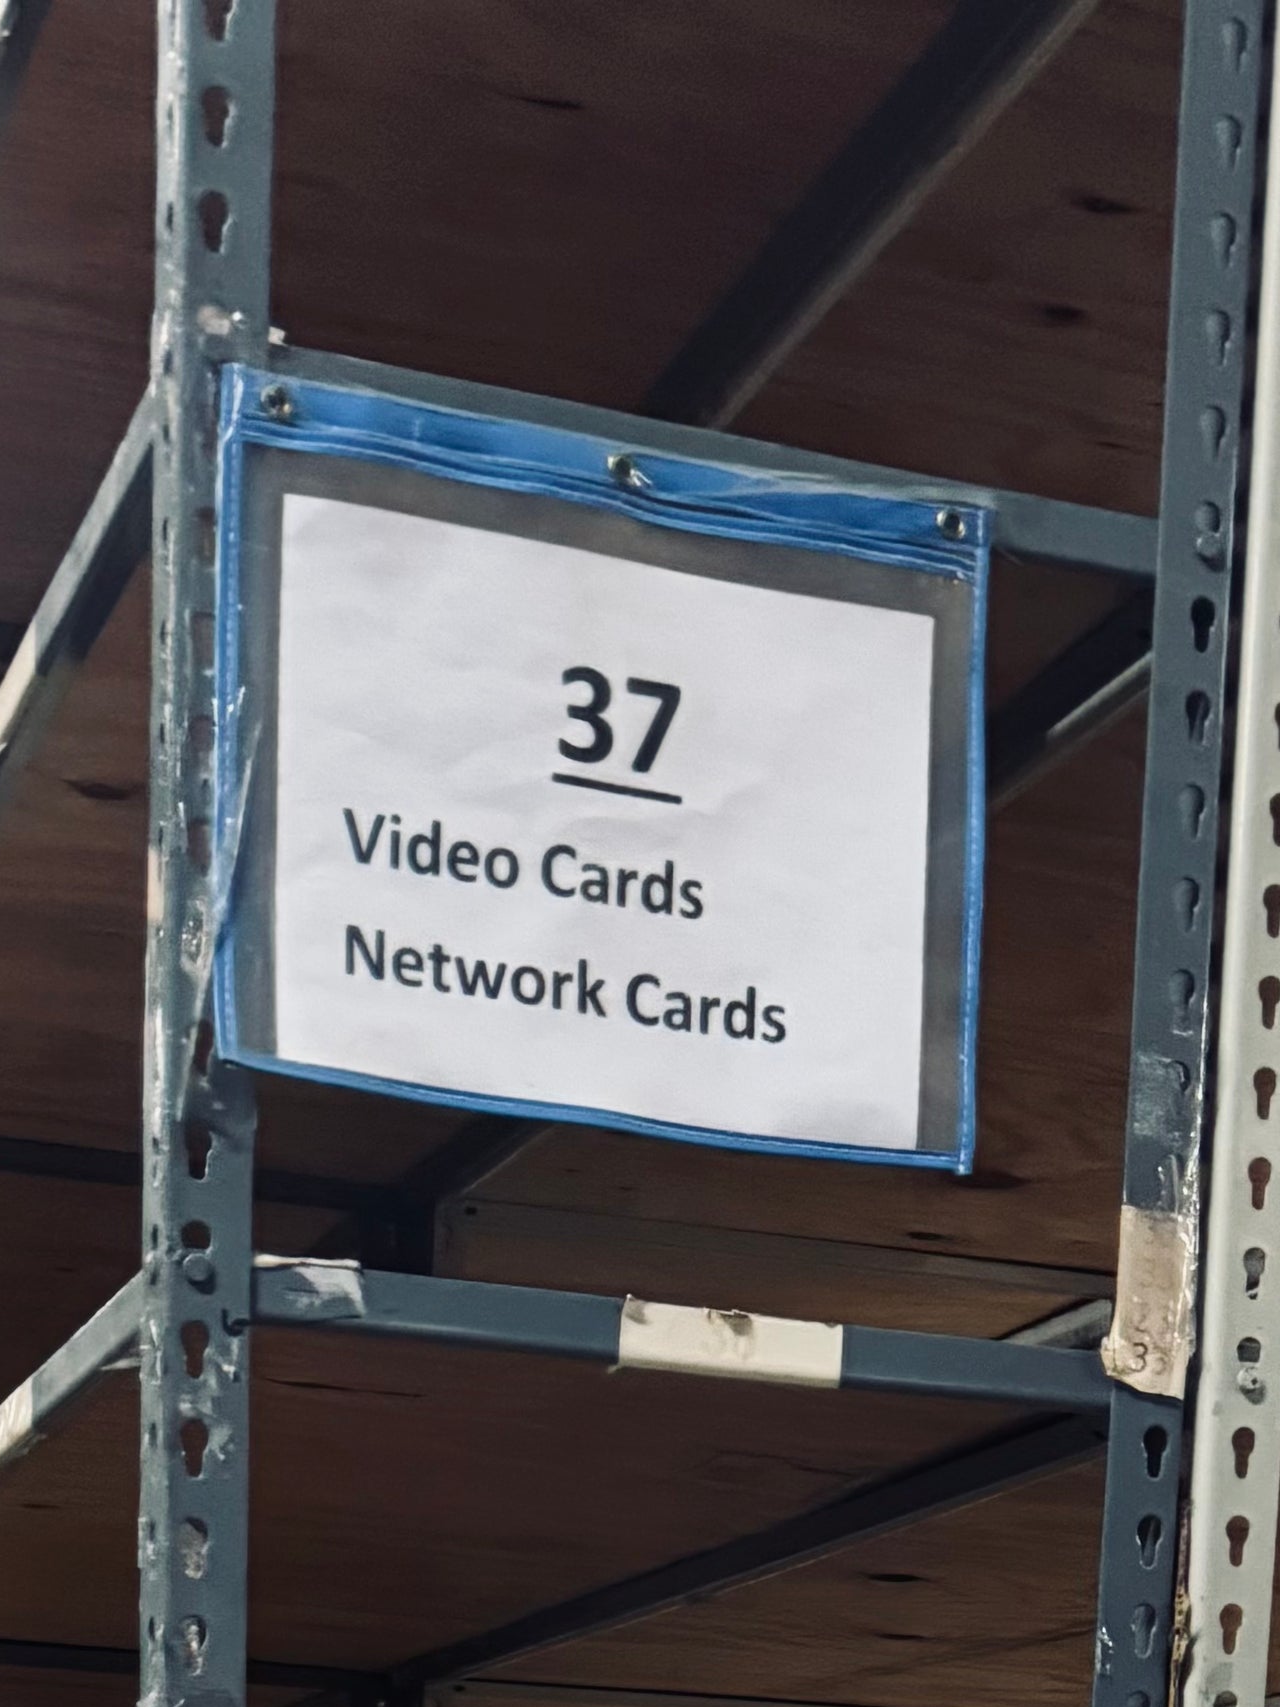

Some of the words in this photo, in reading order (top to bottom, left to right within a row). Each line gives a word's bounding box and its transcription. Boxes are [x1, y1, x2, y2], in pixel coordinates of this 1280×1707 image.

[557, 665, 683, 775] 37
[343, 807, 521, 890] Video
[540, 843, 705, 921] Cards
[345, 923, 607, 1019] Network
[625, 972, 787, 1045] Cards
